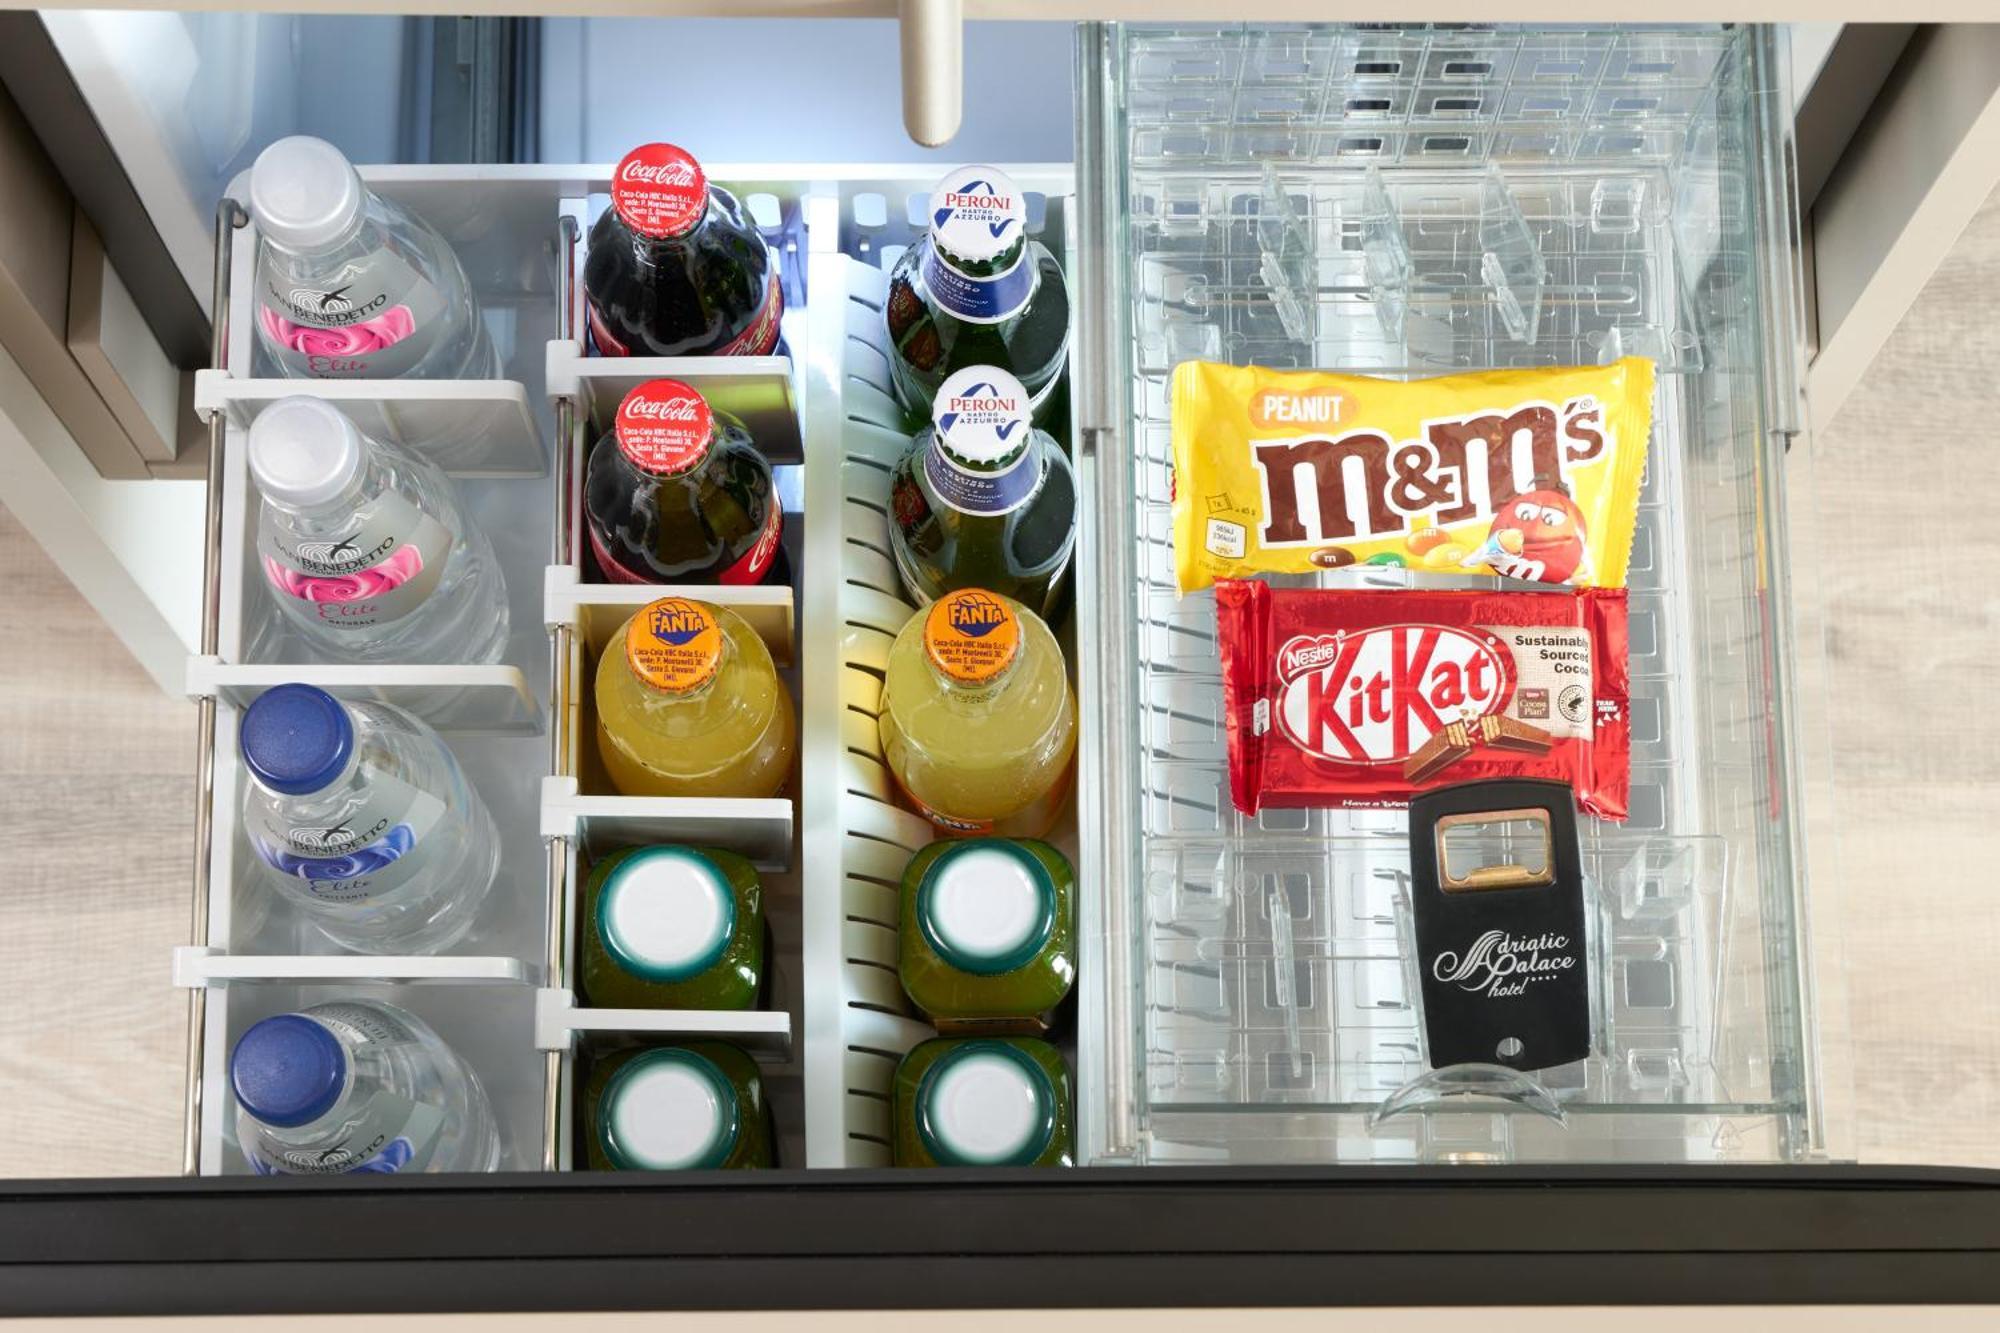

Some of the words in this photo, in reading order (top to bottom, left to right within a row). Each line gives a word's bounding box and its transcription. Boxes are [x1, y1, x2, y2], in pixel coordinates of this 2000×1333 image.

[622, 160, 696, 187] Coca-Cola
[946, 193, 1011, 210] PERONI
[294, 294, 386, 322] BENEDETTO
[625, 395, 700, 421] Coca-Cola
[950, 398, 1015, 411] PERONI
[1263, 395, 1342, 422] PEANUT
[301, 536, 394, 571] BENEDETTO
[650, 611, 703, 634] FANTA
[949, 604, 1002, 625] FANTA
[1308, 627, 1490, 763] KitKat
[1494, 951, 1576, 976] Palace
[1488, 976, 1529, 998] hotel
